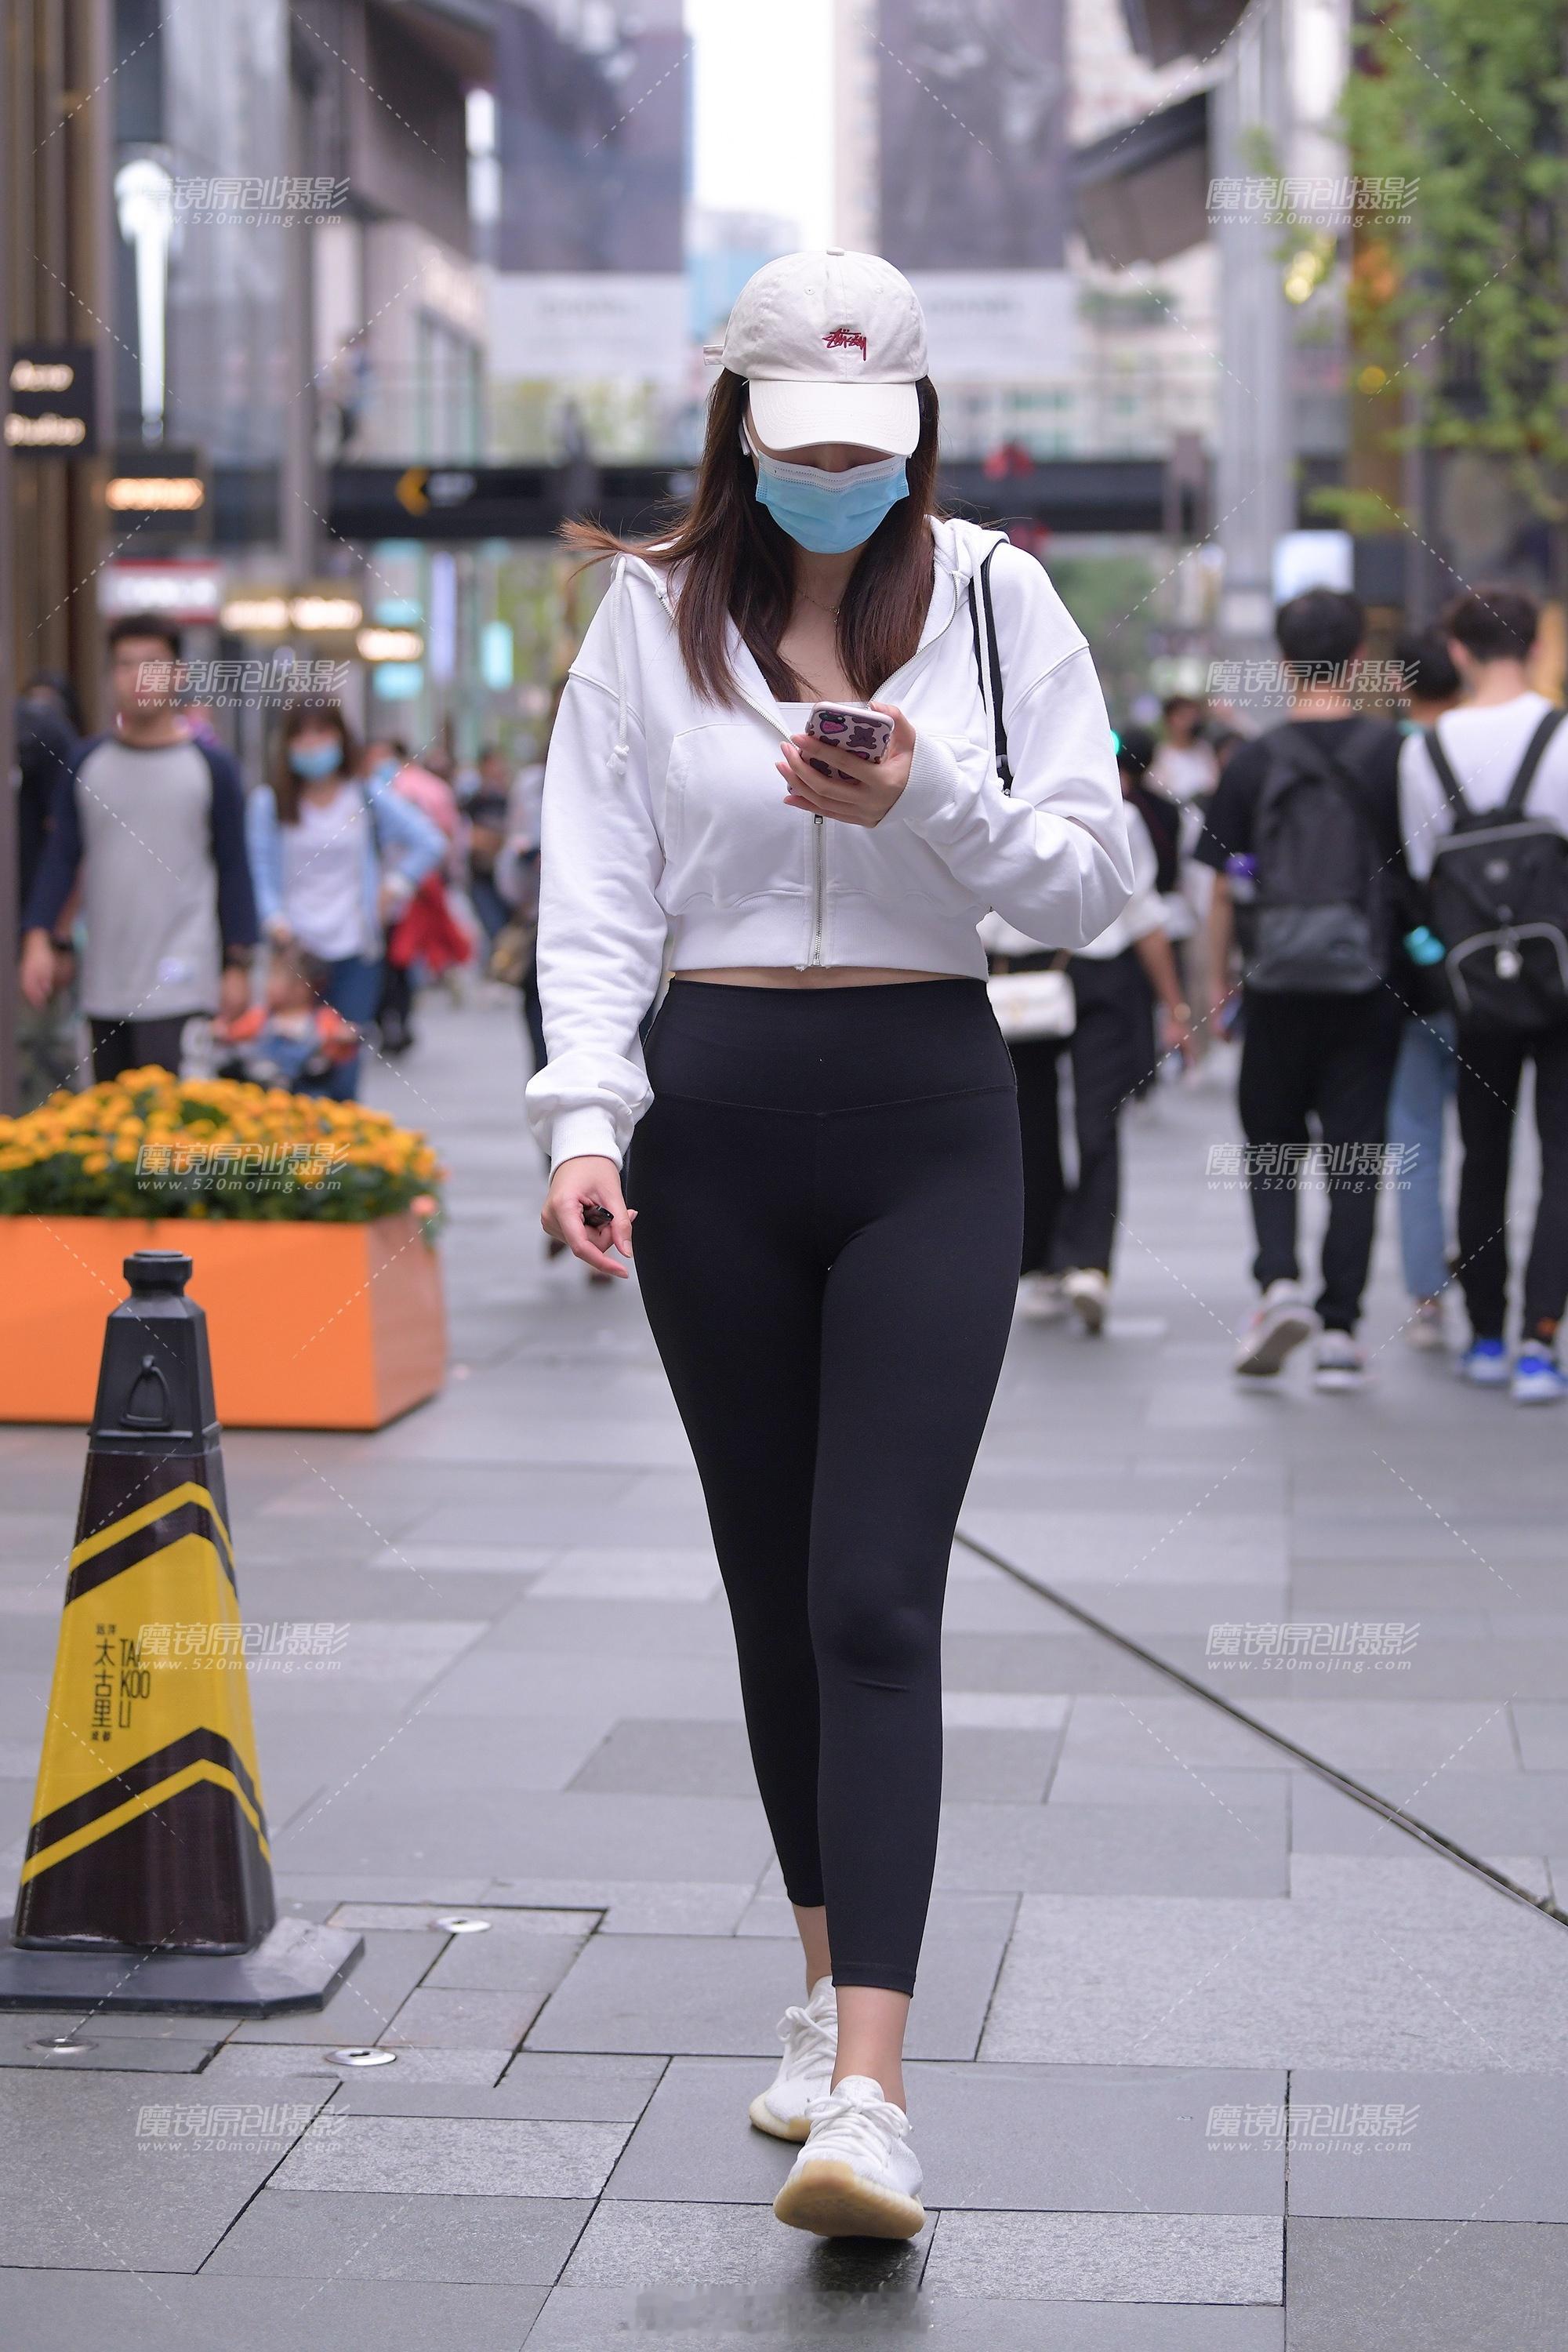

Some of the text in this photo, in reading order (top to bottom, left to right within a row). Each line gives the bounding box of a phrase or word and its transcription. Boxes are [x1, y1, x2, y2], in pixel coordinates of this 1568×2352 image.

[92, 1638, 115, 1727] 太古里
[120, 1669, 151, 1699] KOO
